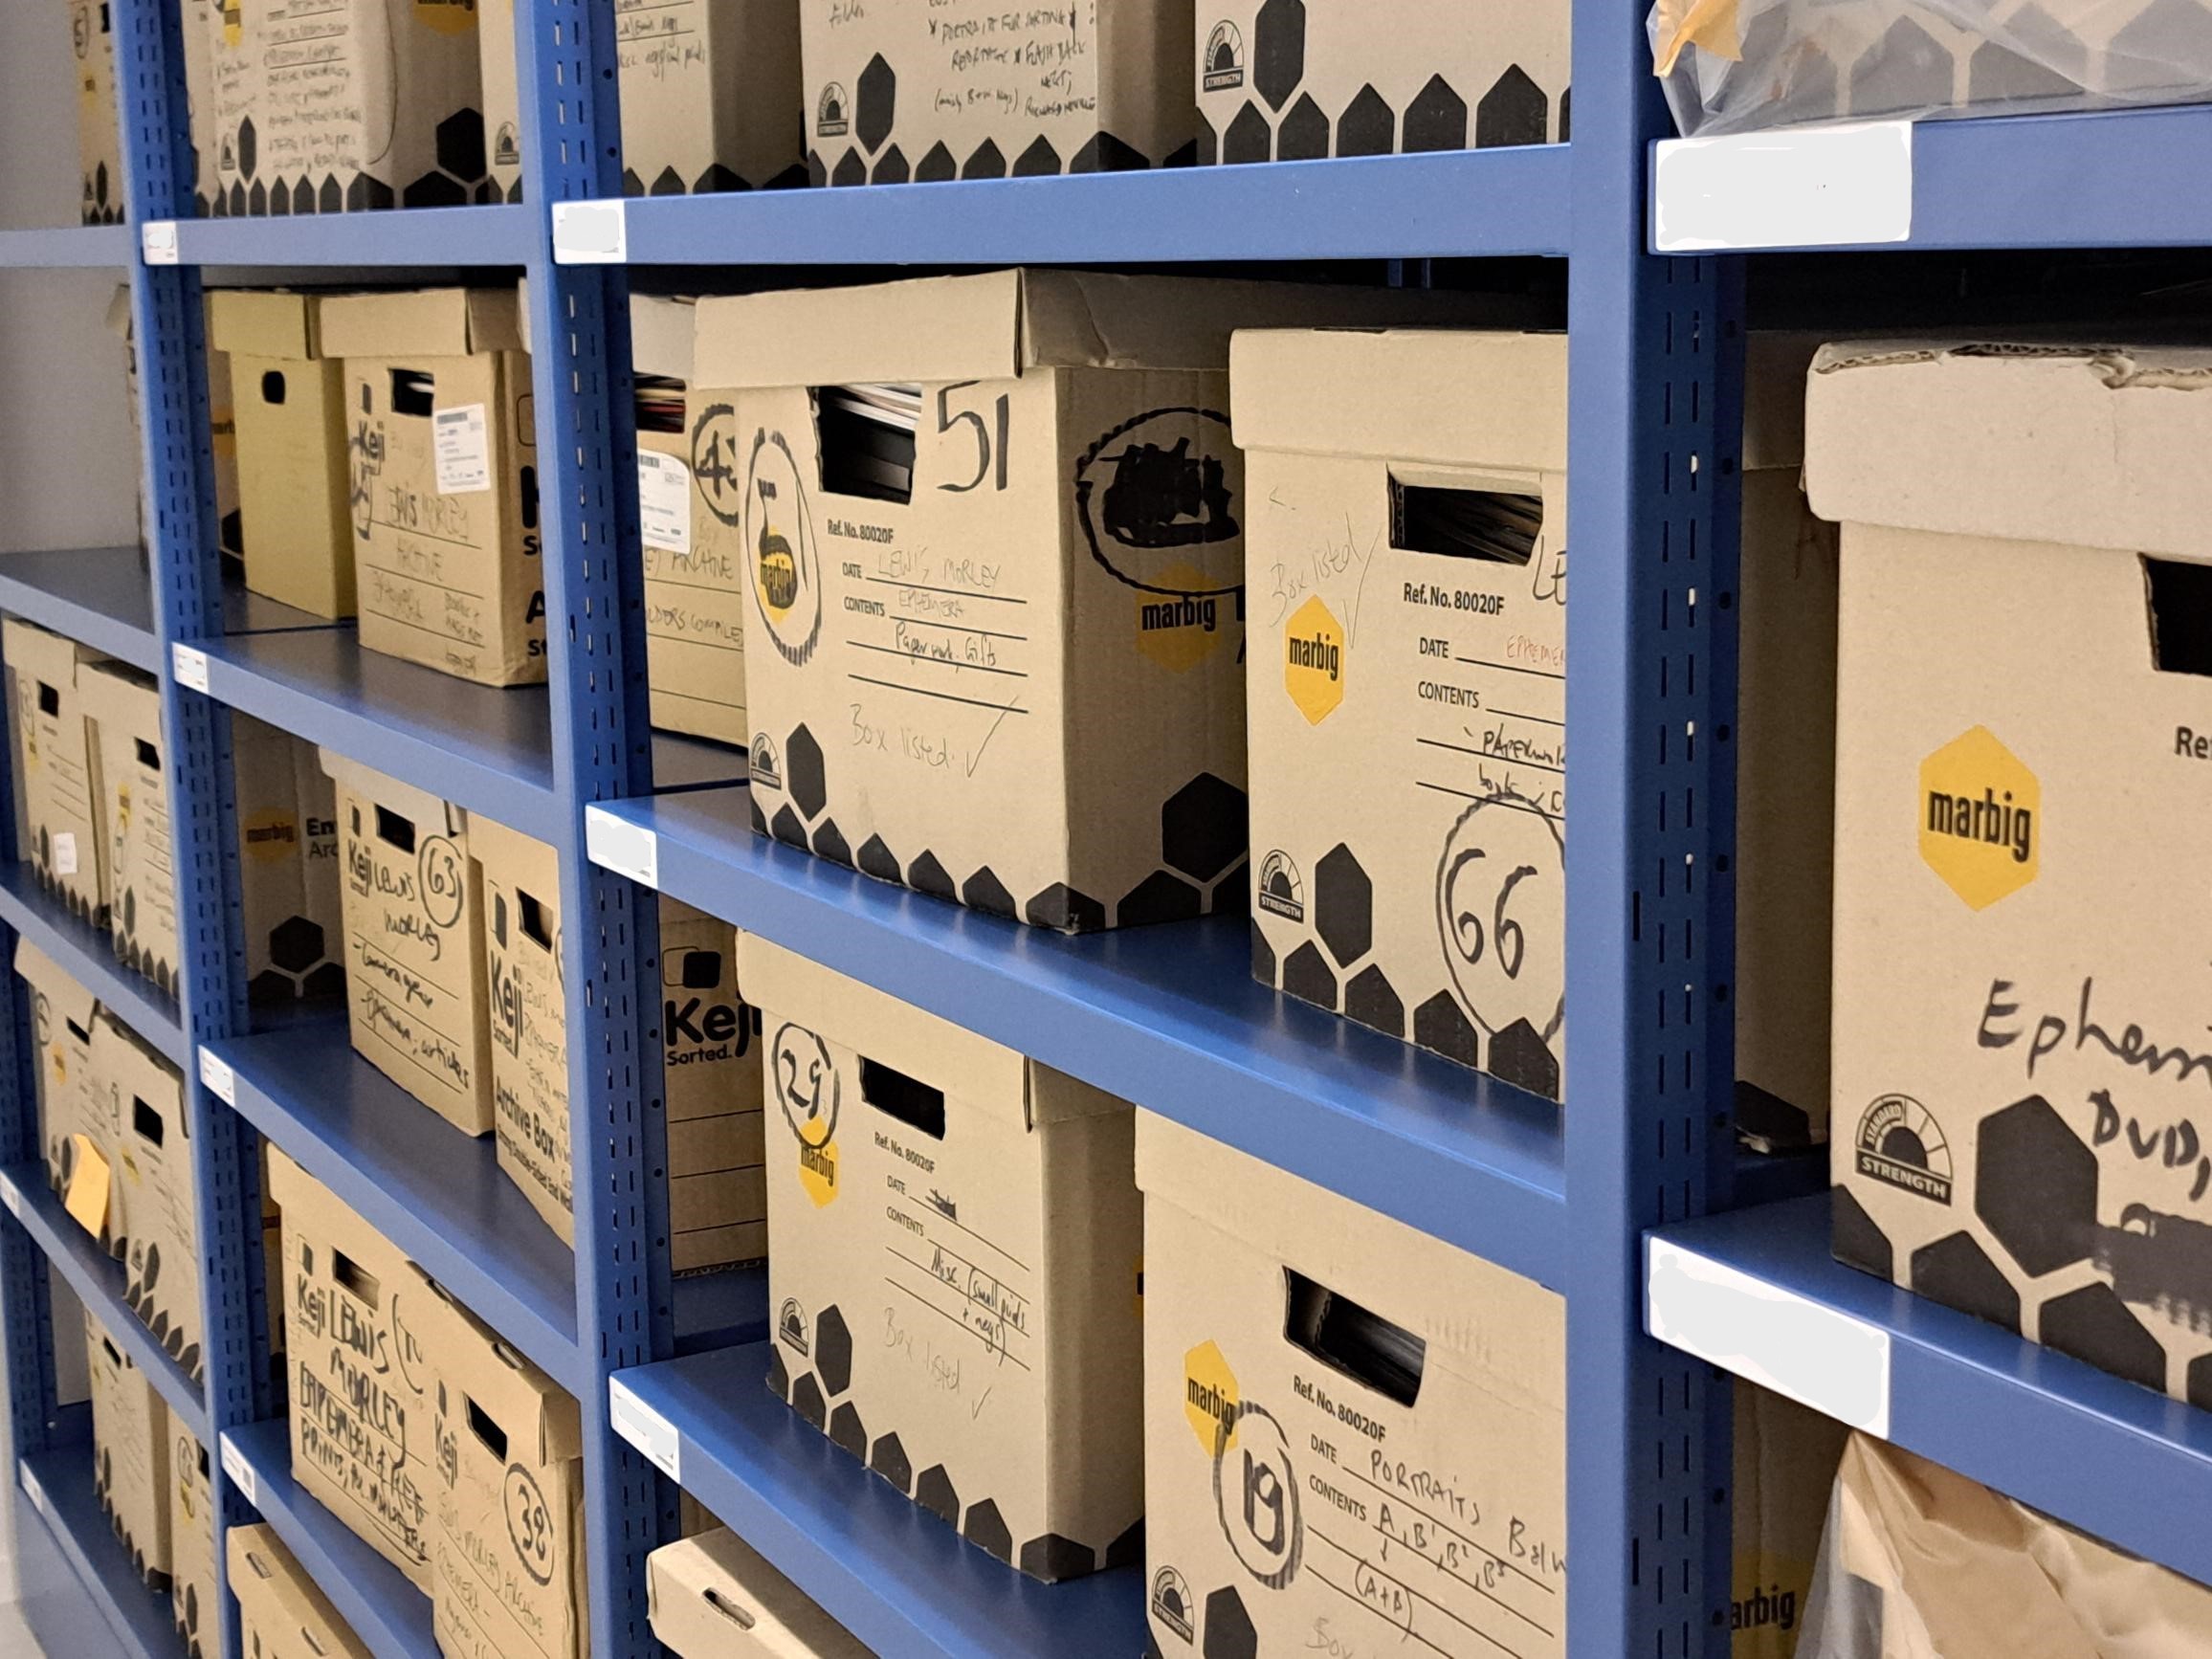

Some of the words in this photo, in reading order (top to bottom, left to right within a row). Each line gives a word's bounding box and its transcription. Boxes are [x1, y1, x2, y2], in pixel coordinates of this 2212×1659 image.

[937, 380, 1008, 492] 51
[828, 519, 843, 537] Ref.
[844, 521, 858, 540] No.
[860, 524, 894, 544] 80020F
[842, 562, 863, 579] DATE
[843, 596, 886, 618] CONTENTS
[1142, 594, 1216, 632] marbig
[1404, 583, 1427, 606] Ref.
[1429, 586, 1452, 609] No.
[1454, 590, 1505, 616] 80020F
[1289, 632, 1339, 681] marbig
[1419, 636, 1449, 658] DATE
[1418, 680, 1479, 709] CONTENTS
[850, 703, 889, 752] Box
[2174, 724, 2212, 762] Re
[1926, 786, 2032, 864] marbig
[430, 848, 457, 898] 63
[1445, 848, 1538, 980] 66
[491, 948, 523, 1058] Keji
[667, 1044, 733, 1067] Sorted.
[533, 1111, 556, 1164] Box
[874, 1132, 889, 1149] Ref.
[890, 1139, 905, 1158] No.
[904, 1147, 935, 1174] 80020F
[800, 1145, 834, 1187] marbig
[887, 1175, 906, 1195] DATE
[1862, 1156, 1947, 1199] STRENGTH
[886, 1206, 924, 1237] CONTENTS
[297, 1272, 326, 1339] Keji
[884, 1306, 913, 1361] Box
[1187, 1378, 1235, 1436] marbig
[1294, 1374, 1315, 1403] Ref.
[1316, 1389, 1336, 1417] No.
[1338, 1405, 1386, 1444] 80020F
[1310, 1432, 1338, 1465] DATE
[1309, 1473, 1367, 1522] CONTENTS
[1730, 1582, 1796, 1631] arbig
